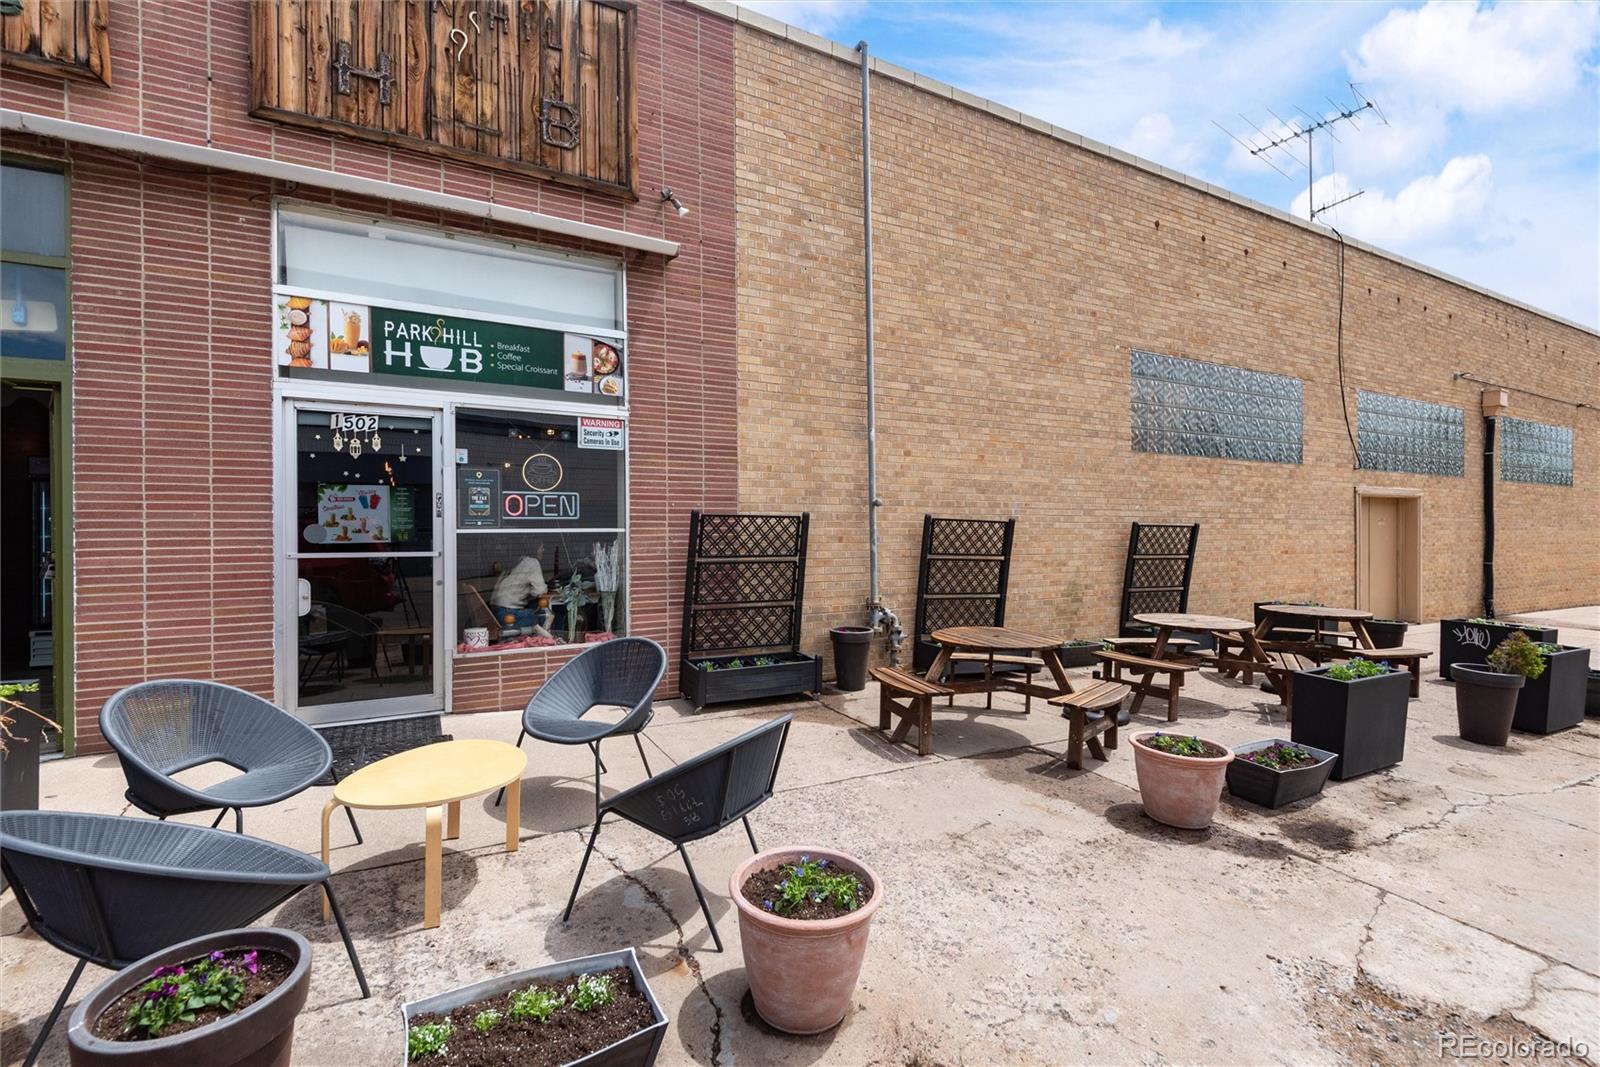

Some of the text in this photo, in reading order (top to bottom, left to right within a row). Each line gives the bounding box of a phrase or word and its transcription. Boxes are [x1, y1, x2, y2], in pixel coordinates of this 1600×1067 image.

[384, 320, 483, 348] PARK HILL
[497, 342, 531, 353] Breakfast
[497, 351, 522, 362] Coffee
[497, 361, 558, 375] Special Croissant
[335, 414, 377, 430] 1502
[582, 418, 620, 428] WARNING
[583, 429, 604, 438] Security
[583, 437, 604, 446] Cameras
[505, 494, 575, 516] OPEN
